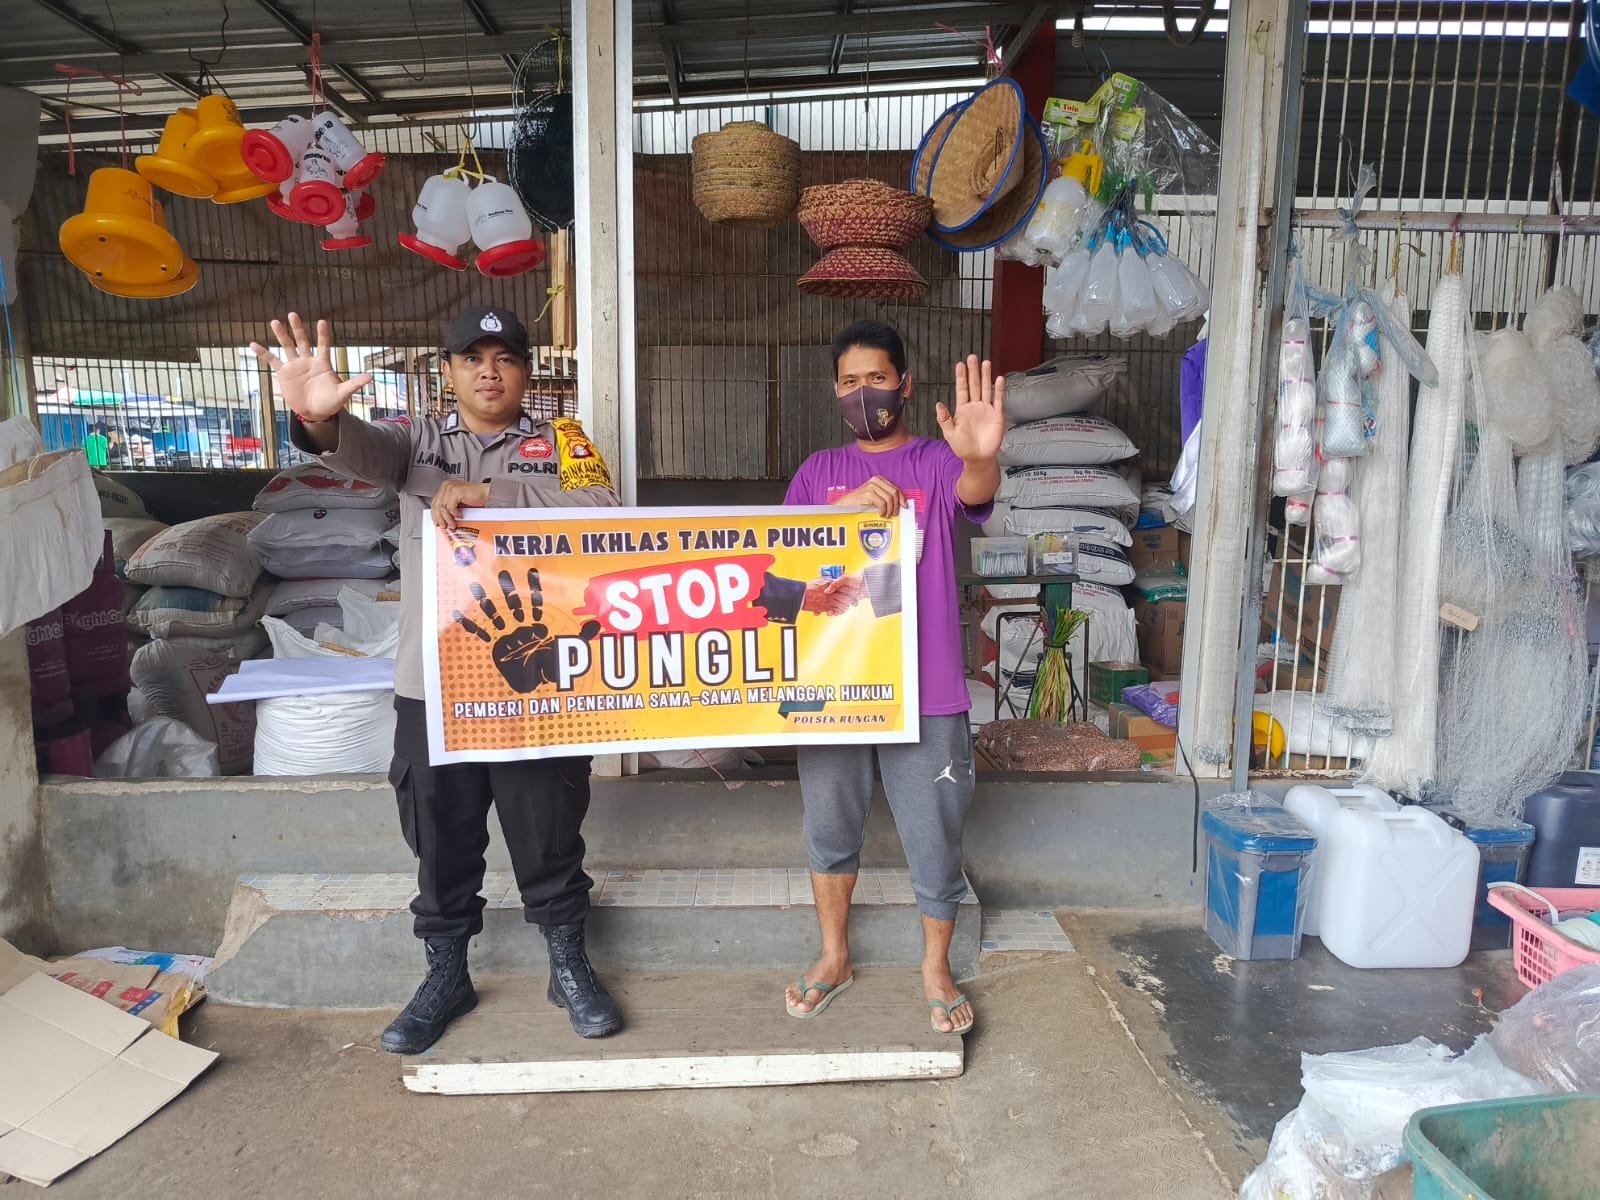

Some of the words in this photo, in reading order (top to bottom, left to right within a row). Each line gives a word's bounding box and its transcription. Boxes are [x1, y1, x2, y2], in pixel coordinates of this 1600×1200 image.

[508, 462, 557, 474] POLRI
[494, 533, 572, 556] KERJA
[581, 530, 669, 554] IKHLAS
[679, 528, 759, 550] TANPA
[767, 526, 846, 548] PUNGLI
[605, 563, 750, 631] STOP
[555, 626, 797, 692] PUNGLI
[453, 699, 523, 718] PEMBERI
[529, 697, 560, 715] DAN
[566, 693, 643, 713] PENERIMA
[649, 689, 742, 708] SAMA-SAMA
[746, 685, 836, 704] MELANGGAR
[840, 684, 894, 701] HUKUM
[793, 716, 836, 724] POLSEK
[840, 715, 886, 723] RUNGAN
